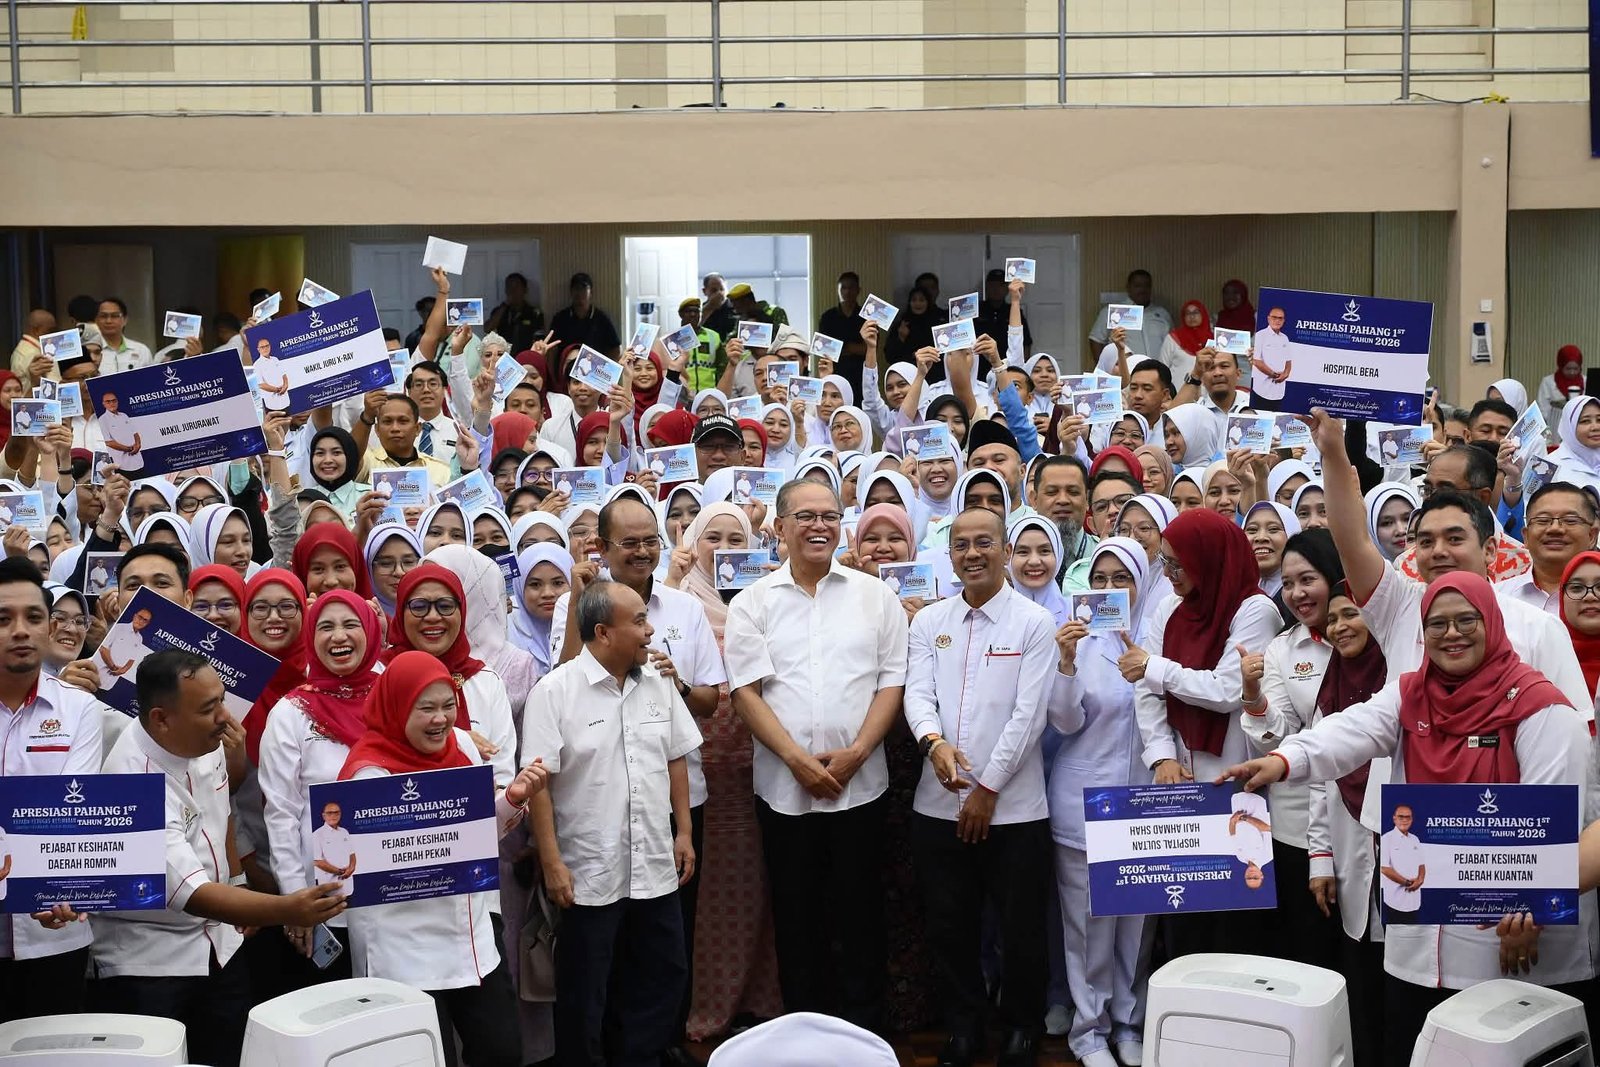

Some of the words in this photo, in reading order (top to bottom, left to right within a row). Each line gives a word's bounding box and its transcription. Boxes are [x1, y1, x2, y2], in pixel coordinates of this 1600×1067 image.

[339, 326, 358, 337] 2026
[1296, 320, 1347, 333] APRESIASI
[1350, 325, 1390, 336] PAHANG
[280, 331, 318, 348] APRESIASI
[319, 321, 348, 335] PAHANG
[1375, 337, 1400, 347] 2026
[304, 363, 322, 374] WAKIL
[323, 357, 336, 368] JURU
[337, 352, 354, 363] X-RAY
[1323, 364, 1358, 376] HOSPITAL
[1360, 367, 1379, 378] BERA
[129, 389, 175, 404] APRESIASI
[176, 381, 212, 395] PAHANG
[201, 387, 223, 398] 2026
[160, 426, 181, 436] WAKIL
[182, 416, 220, 432] JURURAWAT
[12, 808, 71, 817] APRESIASI
[74, 806, 120, 816] PAHANG
[123, 805, 137, 815] 1ST
[354, 804, 409, 819] APRESIASI
[411, 800, 454, 812] PAHANG
[439, 808, 466, 819] 2026
[104, 817, 132, 826] 2026
[1426, 817, 1485, 827] APRESIASI
[1487, 817, 1534, 827] PAHANG
[1536, 817, 1550, 827] 1ST
[1130, 825, 1151, 836] SHAH
[1153, 824, 1180, 834] AHMAD
[1184, 823, 1200, 833] HAJI
[1518, 829, 1546, 838] 2026
[382, 836, 414, 850] PEJABAT
[416, 831, 459, 846] KESIHATAN
[1132, 840, 1161, 851] SULTAN
[1163, 838, 1200, 849] HOSPITAL
[40, 842, 76, 853] PEJABAT
[78, 841, 124, 852] KESIHATAN
[392, 852, 423, 864] DAERAH
[425, 848, 451, 861] PEKAN
[1454, 854, 1489, 864] PEJABAT
[1492, 854, 1537, 864] KESIHATAN
[48, 859, 82, 869] DAERAH
[84, 858, 117, 868] ROMPIN
[1119, 865, 1146, 874] 2026
[1132, 873, 1175, 884] PAHANG
[1177, 870, 1232, 882] APRESIASI
[1458, 871, 1492, 881] DAERAH
[1494, 871, 1533, 881] KUANTAN
